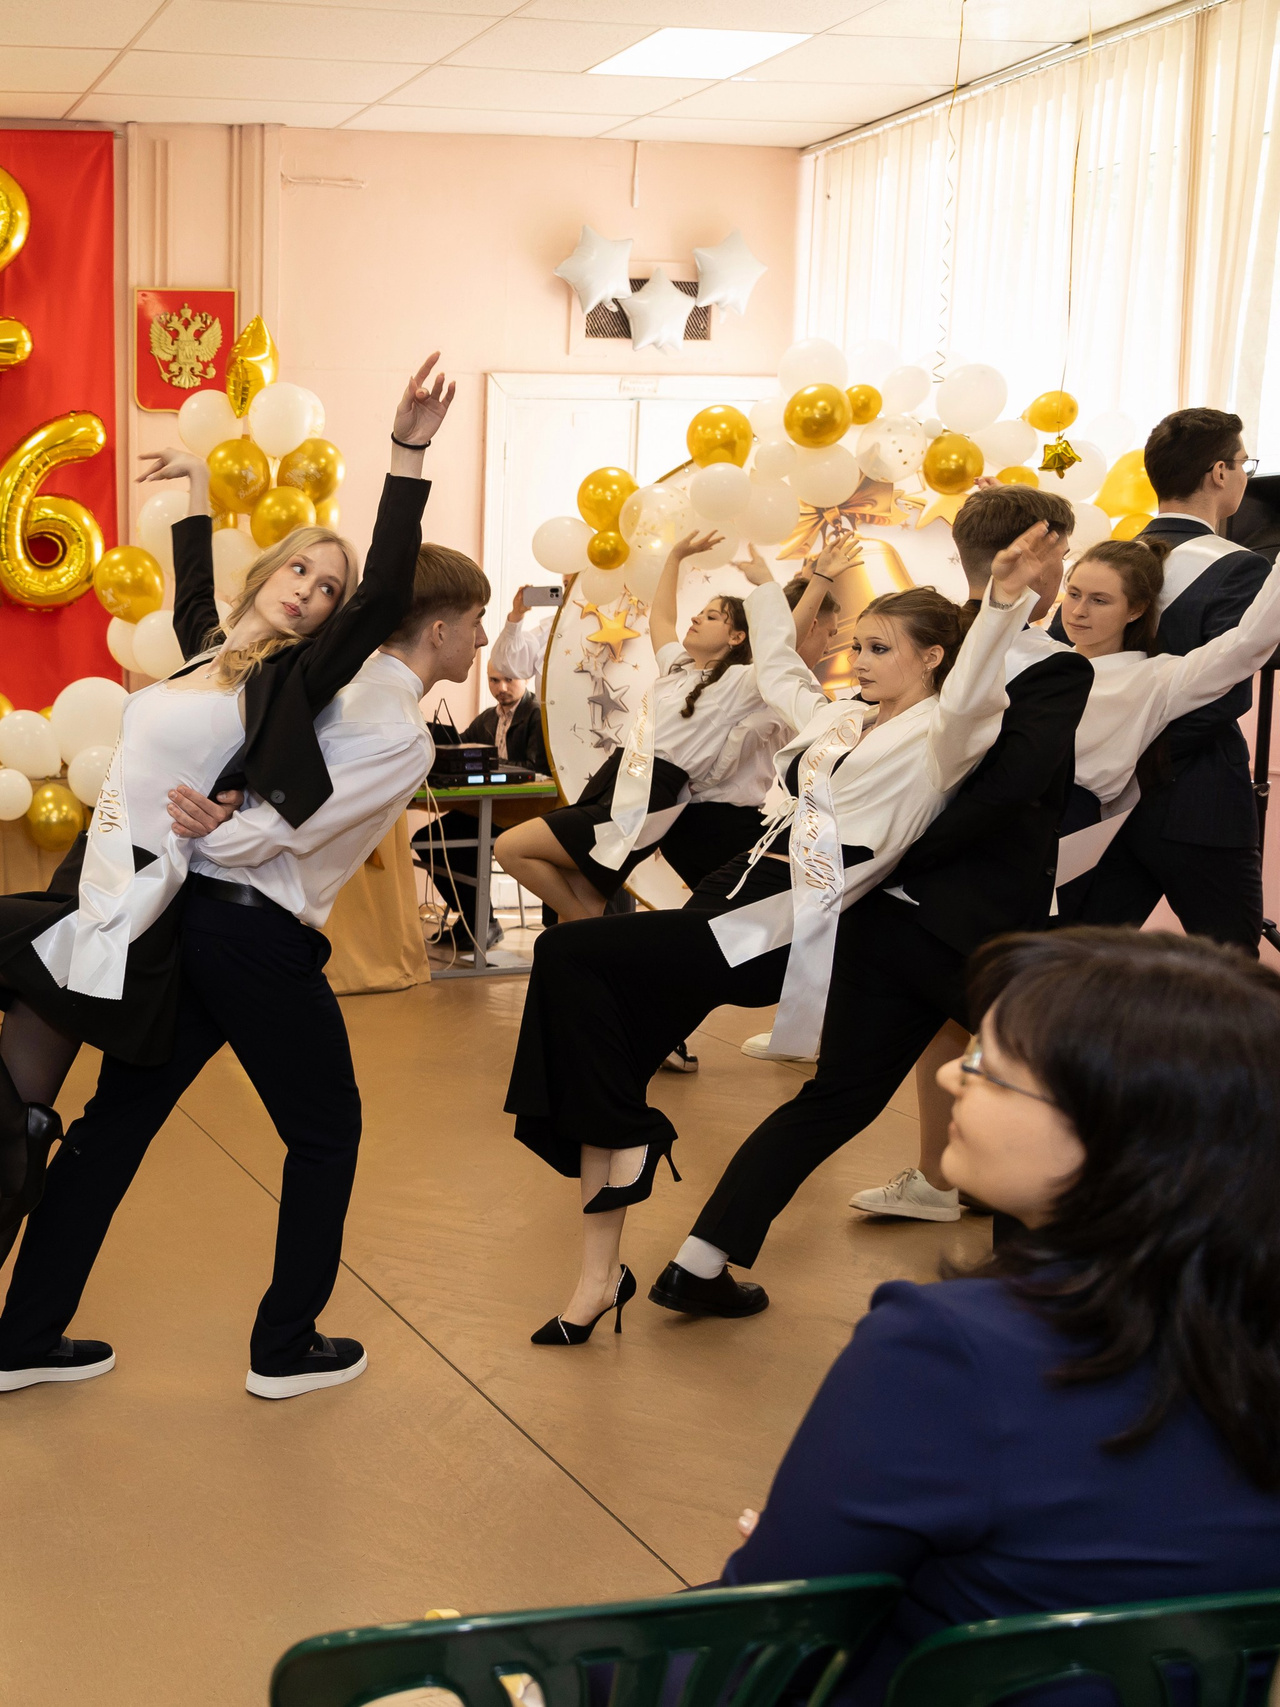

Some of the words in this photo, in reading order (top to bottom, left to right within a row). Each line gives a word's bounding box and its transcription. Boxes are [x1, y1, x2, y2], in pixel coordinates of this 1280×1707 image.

[627, 751, 649, 780] 2026
[98, 789, 123, 834] 2026
[802, 845, 837, 895] 2026
